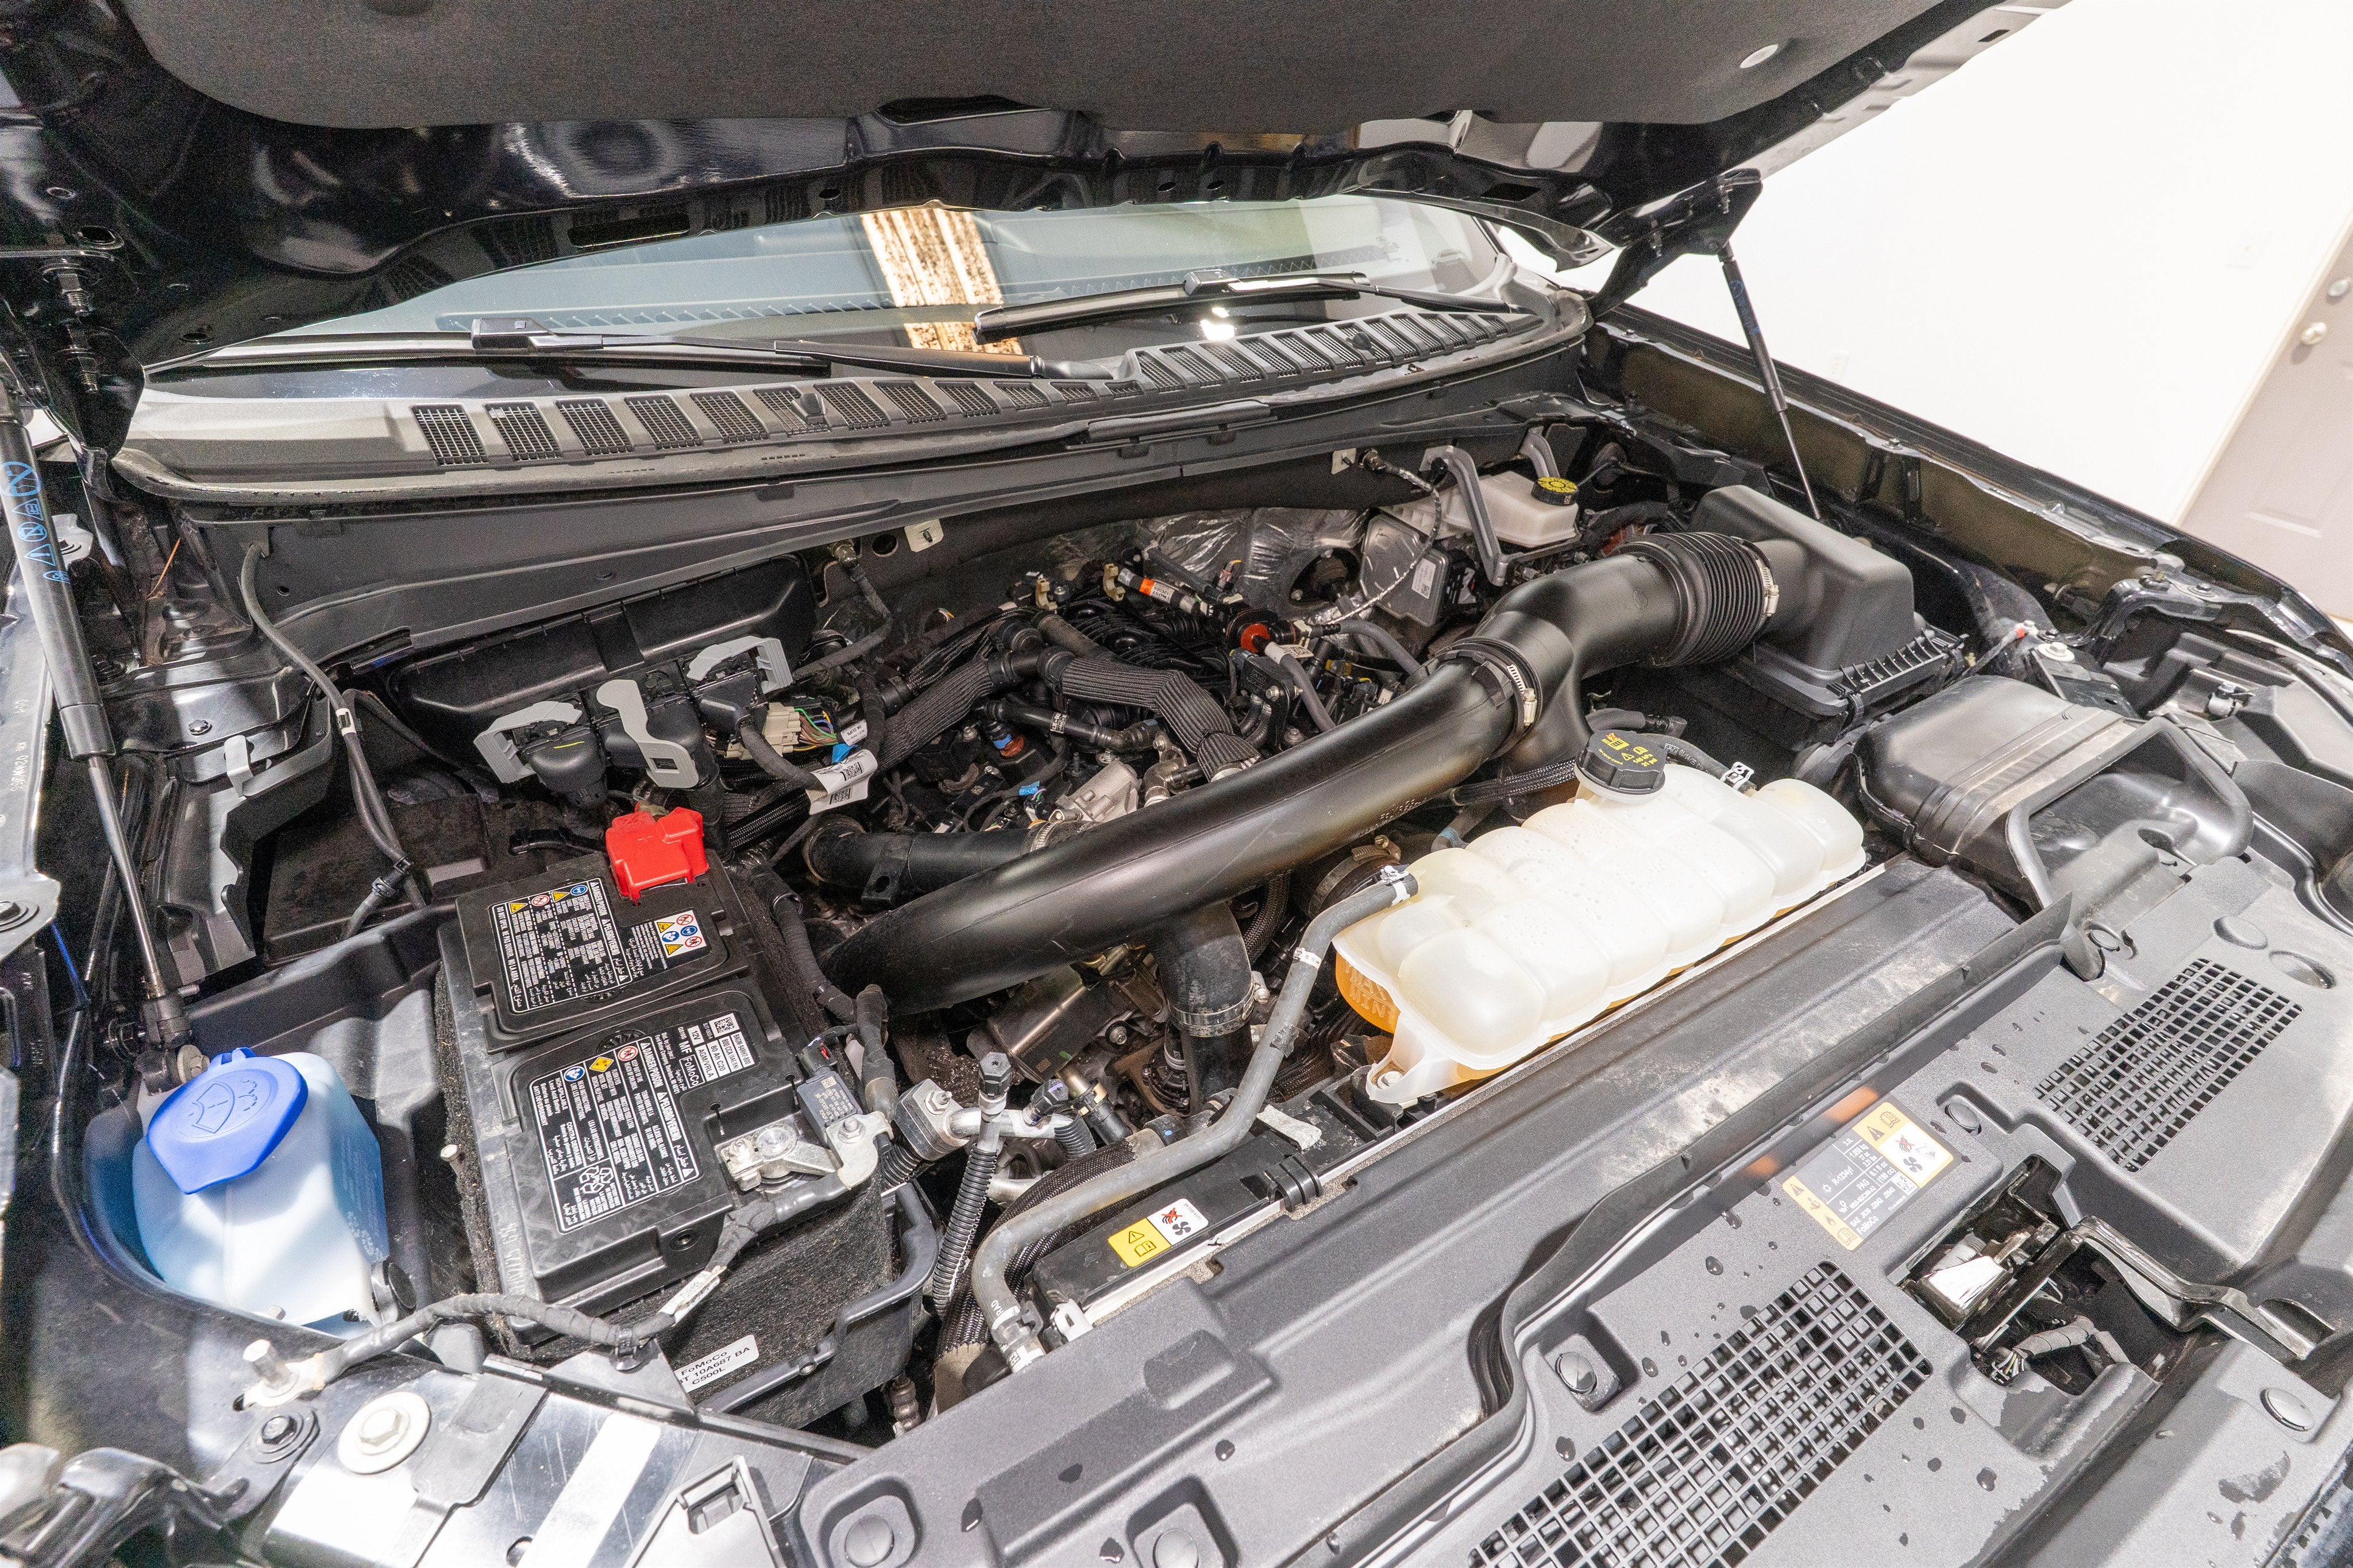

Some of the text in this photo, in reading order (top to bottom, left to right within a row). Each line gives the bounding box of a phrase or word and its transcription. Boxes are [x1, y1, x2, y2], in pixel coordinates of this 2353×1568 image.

[592, 886, 620, 955] DANGER/POISON PELIGRO/VENENO
[505, 943, 514, 957] OUVRIR.
[511, 971, 519, 982] ABRA.
[1351, 967, 1388, 1001] MAX
[1348, 983, 1388, 1018] MIN
[679, 1041, 692, 1053] MF
[692, 1030, 713, 1077] 12V AGM/VRLA
[725, 1046, 733, 1055] CCA
[730, 1055, 738, 1068] (SAE/EN)
[734, 1034, 750, 1064] BAGM-94RH7-800
[660, 1051, 669, 1065] Company,
[665, 1065, 674, 1080] Dearborn,
[682, 1057, 699, 1085] FoMoCo
[717, 1061, 725, 1071] C20
[555, 1077, 568, 1110] NON-SPILLABLE
[641, 1090, 649, 1100] TENIR
[643, 1048, 681, 1141] DANGER/POISON PELIGRO/VENENO
[535, 1095, 548, 1126] DÉVERSEMENT
[545, 1104, 553, 1116] plomb
[566, 1122, 582, 1166] CONTRA DERRAMES
[1843, 1138, 1853, 1146] 3.5L
[1831, 1166, 1853, 1185] R-1234yf
[1869, 1168, 1878, 1176] 6.1
[1887, 1167, 1896, 1175] cc)
[1857, 1179, 1869, 1190] PAG
[1850, 1216, 1861, 1227] SAE
[1856, 1216, 1878, 1235] FoMoCo
[989, 1300, 1006, 1316] RAD
[681, 1351, 727, 1376] FoMoCo
[694, 1356, 731, 1377] 10A687
[735, 1347, 750, 1357] BA
[692, 1368, 726, 1385] C500L
